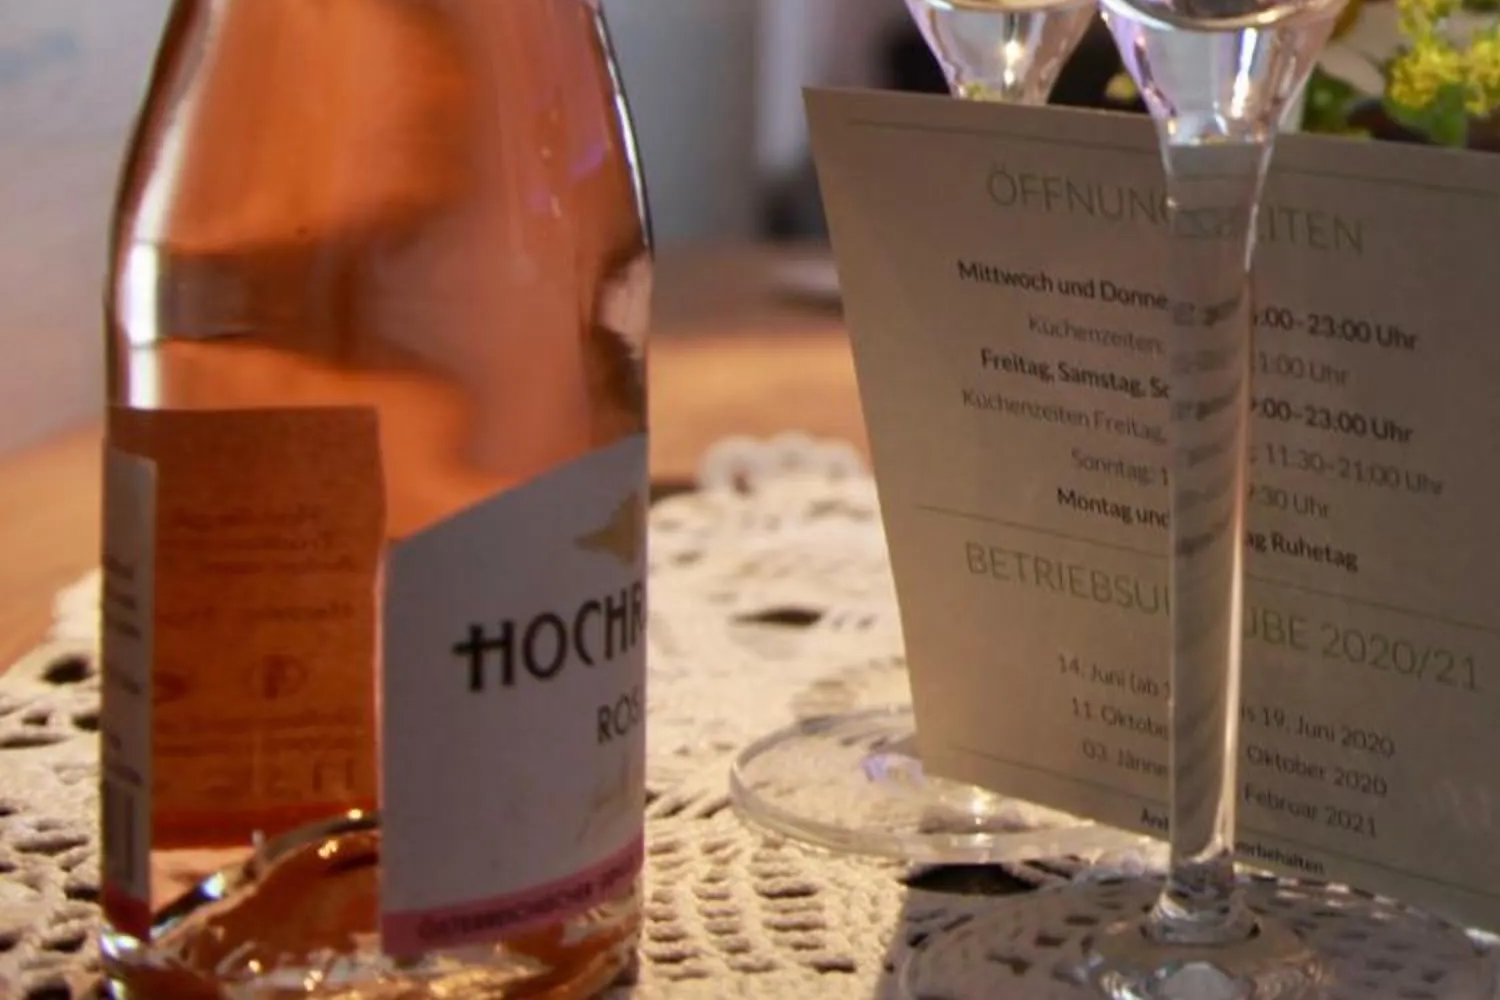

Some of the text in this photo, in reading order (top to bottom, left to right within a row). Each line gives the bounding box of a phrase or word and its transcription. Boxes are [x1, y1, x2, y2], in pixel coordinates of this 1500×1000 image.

[956, 258, 1053, 293] Mittwoch
[1057, 278, 1096, 300] und
[1099, 278, 1169, 311] Donne
[1371, 323, 1419, 351] Uhr
[1308, 360, 1348, 387] Uhr
[1369, 414, 1415, 443] Uhr
[1292, 491, 1330, 518] Uhr
[1404, 469, 1444, 495] Uhr
[1056, 487, 1133, 525] Montag
[1269, 530, 1359, 575] Ruhetag
[1320, 620, 1483, 692] 2020/21
[1099, 704, 1169, 742] Oktobe
[1245, 743, 1327, 780] Oktober
[1332, 766, 1389, 799] 2020
[1294, 714, 1336, 743] Juni
[1340, 724, 1397, 759] 2020
[1116, 747, 1169, 778] Jänne
[1243, 781, 1319, 822] Februar
[1323, 804, 1379, 840] 2021
